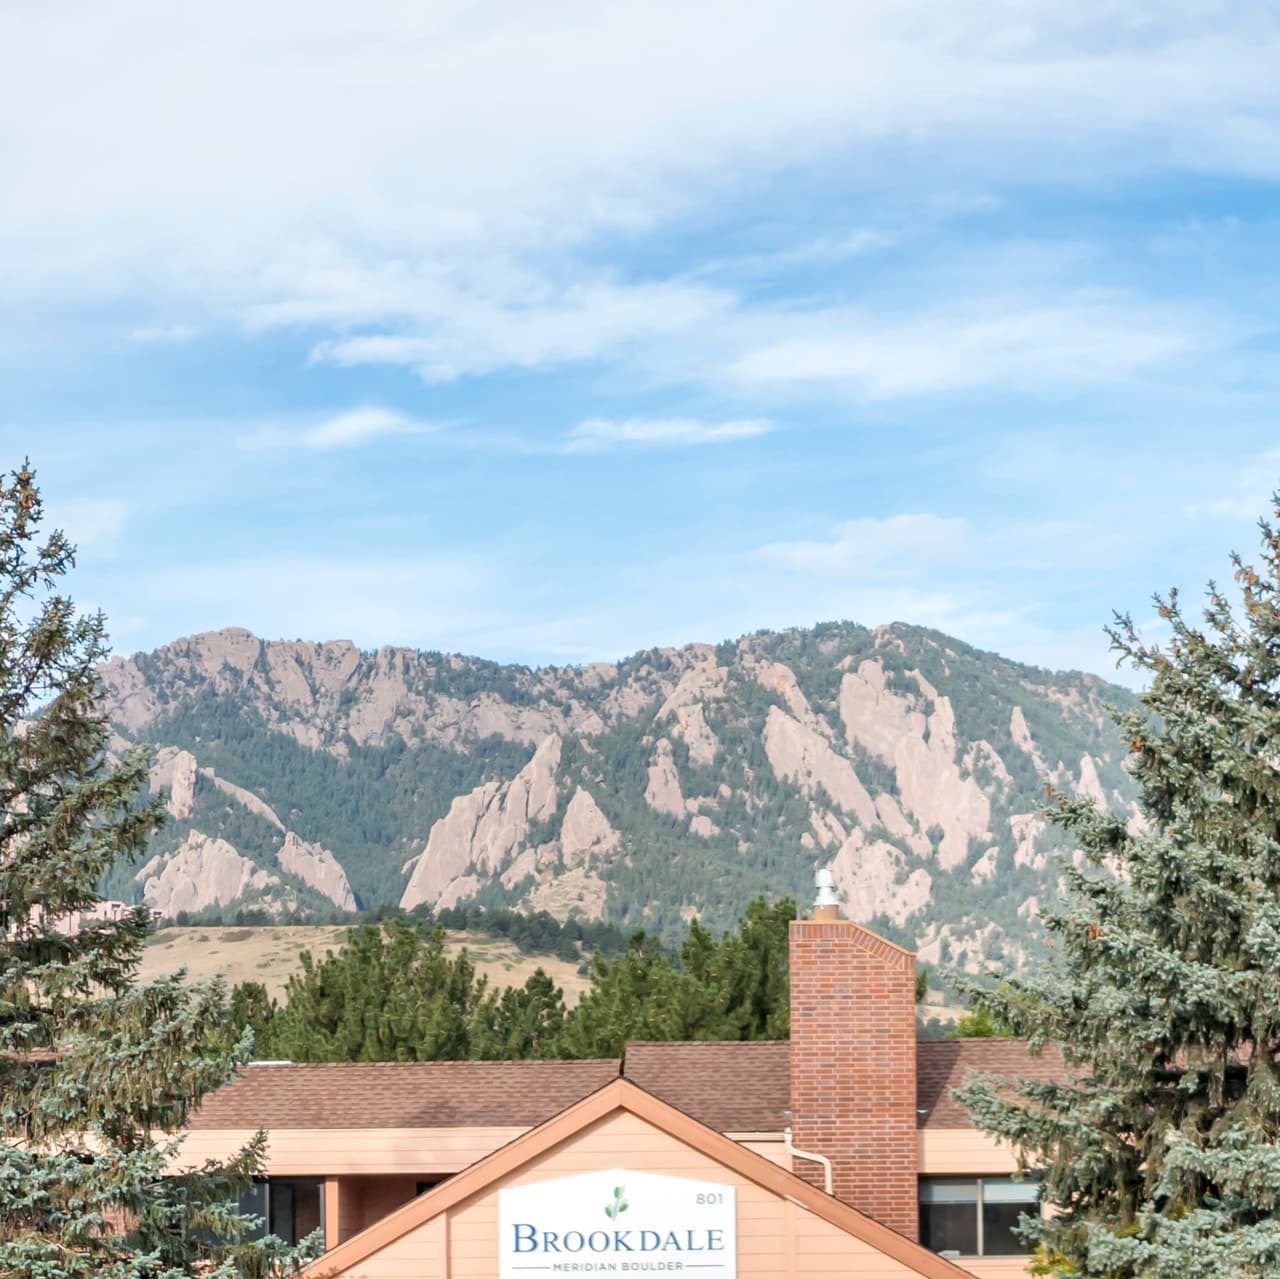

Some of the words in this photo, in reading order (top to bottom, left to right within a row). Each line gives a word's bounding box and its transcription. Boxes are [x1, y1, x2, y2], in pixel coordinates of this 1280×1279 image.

[696, 1193, 723, 1205] 801
[511, 1223, 725, 1253] BROOKDALE
[553, 1263, 617, 1272] MERIDIAN
[621, 1262, 684, 1271] BOULDER
